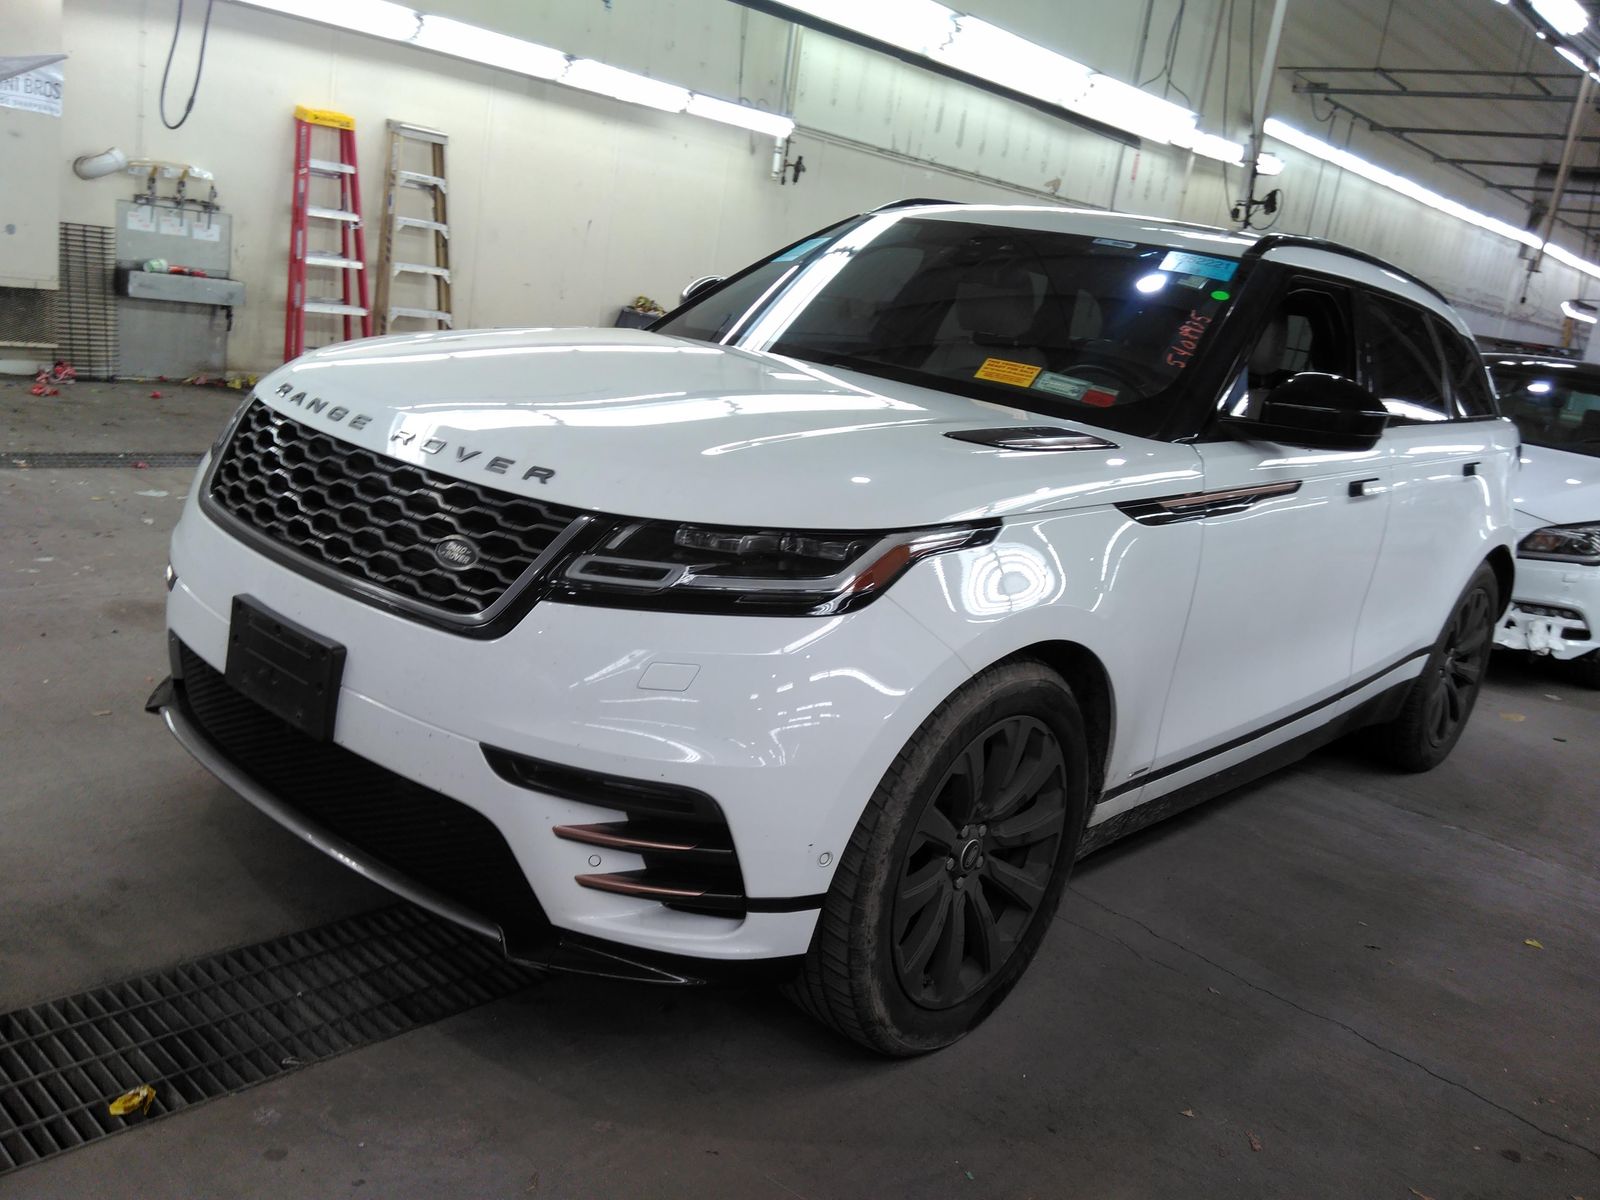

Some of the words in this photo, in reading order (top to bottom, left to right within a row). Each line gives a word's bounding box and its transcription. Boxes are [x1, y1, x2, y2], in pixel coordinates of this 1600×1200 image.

[24, 78, 62, 99] BROS
[275, 382, 373, 431] RANGE
[390, 430, 556, 484] ROVER
[444, 549, 471, 564] ROVER
